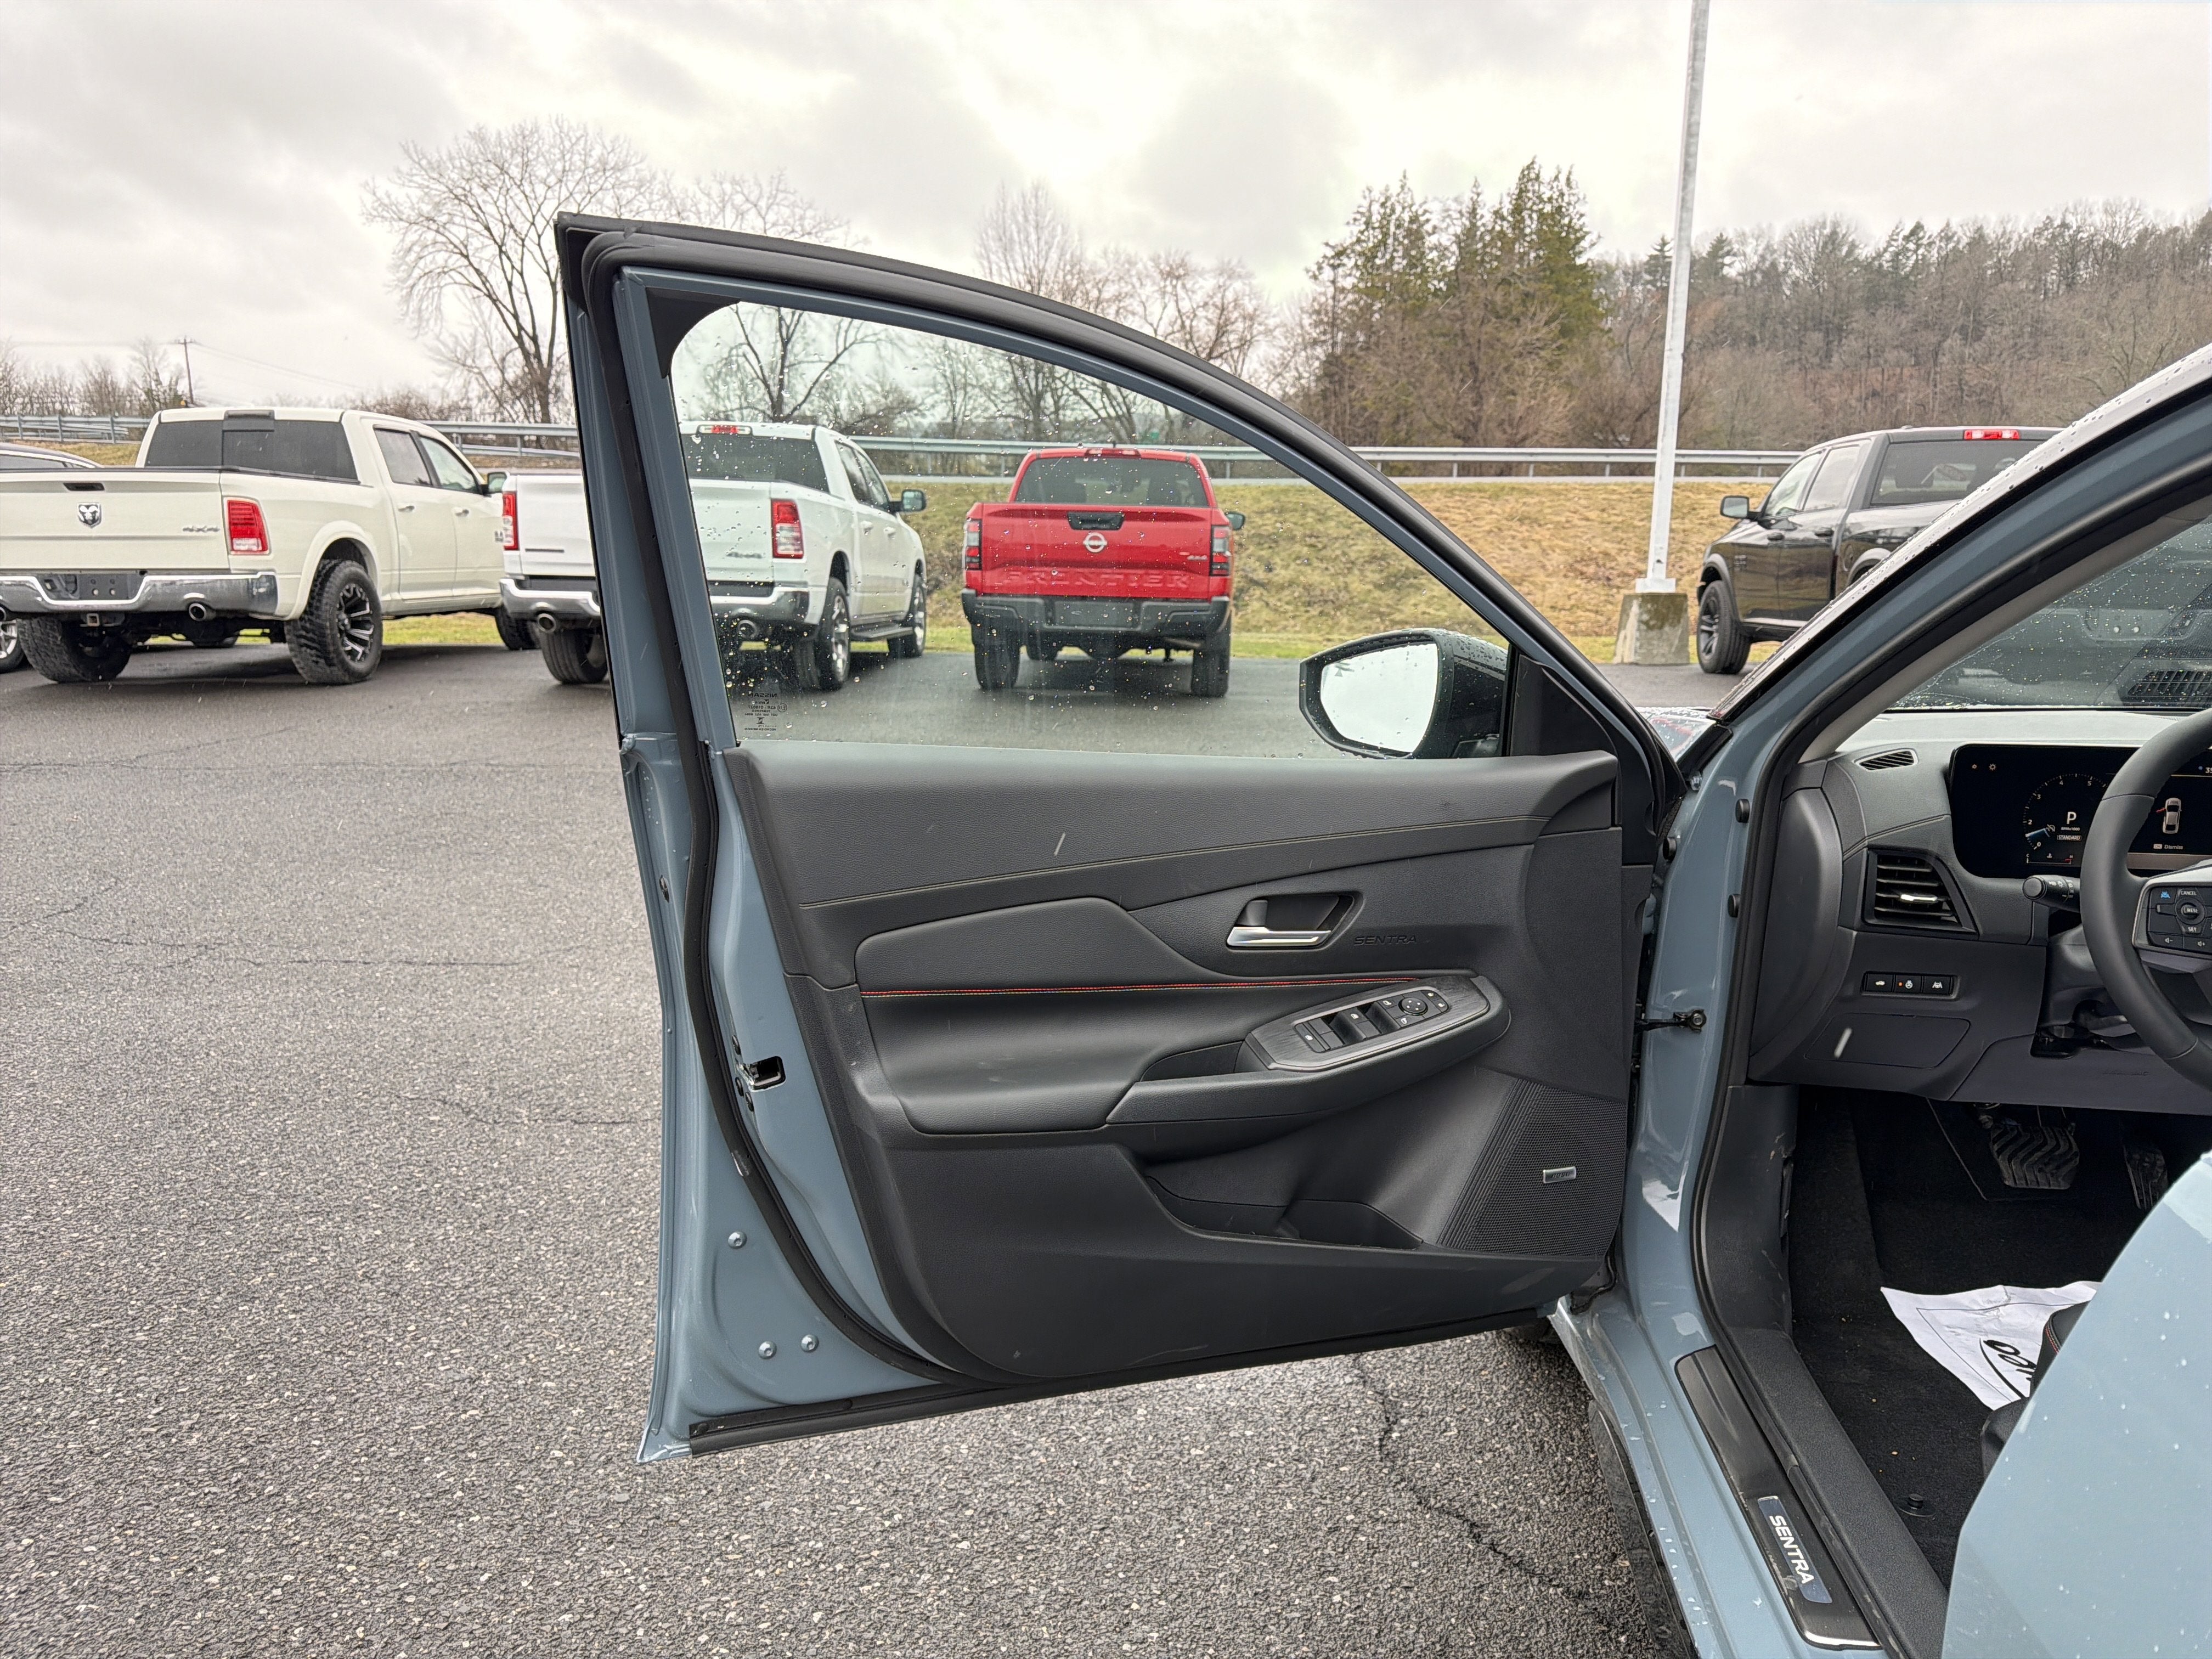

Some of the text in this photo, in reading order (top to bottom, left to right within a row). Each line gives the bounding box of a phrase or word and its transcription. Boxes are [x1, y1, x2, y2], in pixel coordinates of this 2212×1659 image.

[1003, 569, 1189, 588] FRONTIER
[2067, 811, 2077, 825] P
[1353, 935, 1416, 946] SENTRA
[1769, 1515, 1814, 1584] SENTRA
